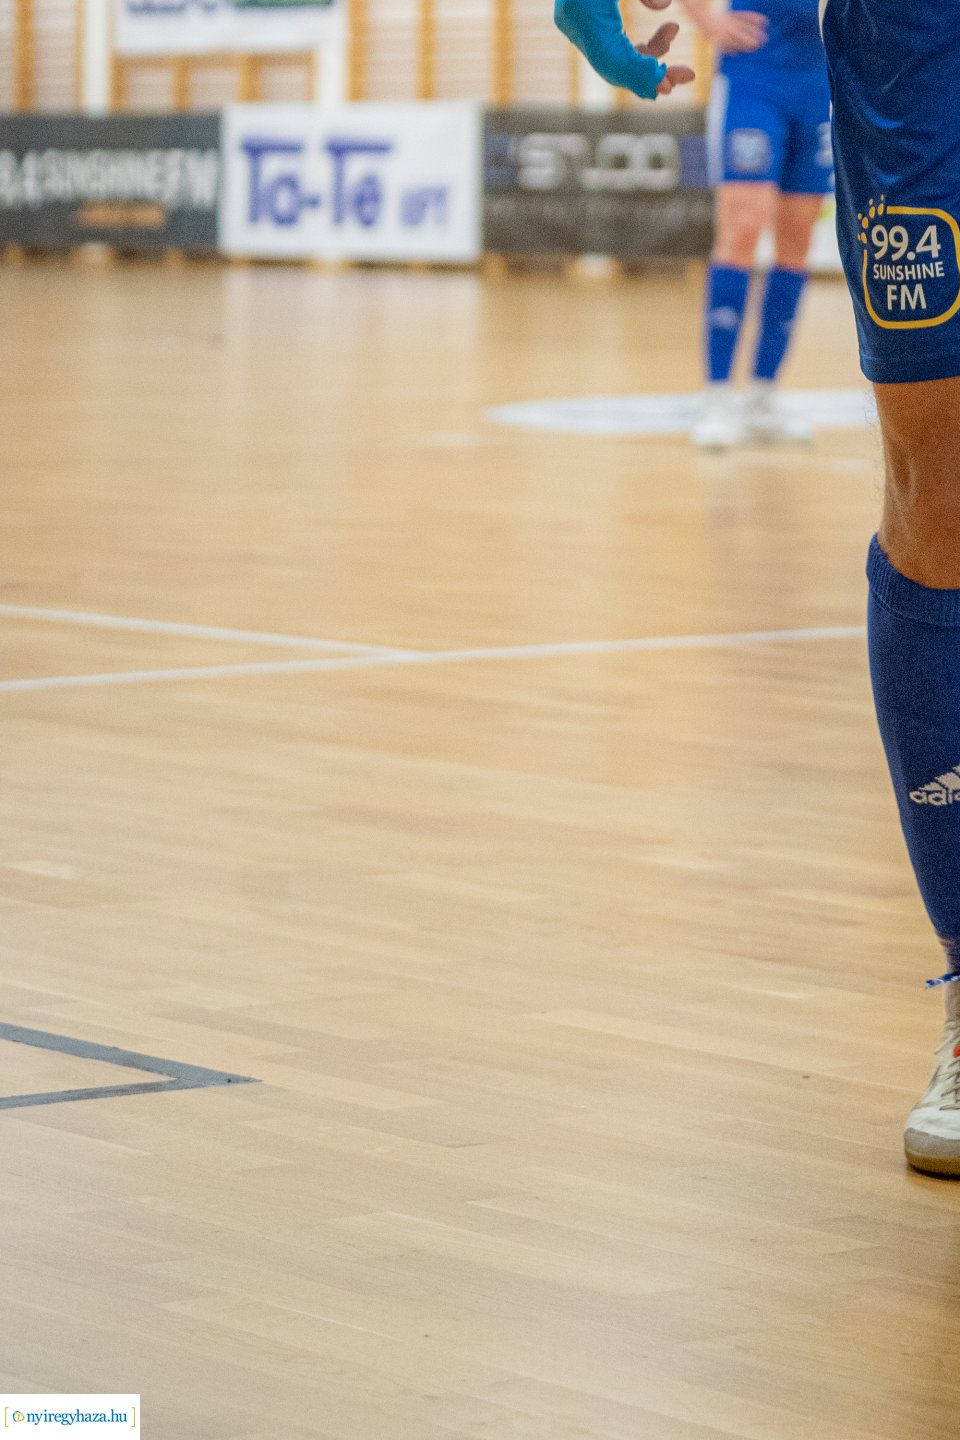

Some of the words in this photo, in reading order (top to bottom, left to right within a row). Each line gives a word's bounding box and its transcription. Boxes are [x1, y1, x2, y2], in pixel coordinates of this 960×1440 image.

[871, 224, 942, 261] 99.4
[873, 261, 945, 281] SUNSHINE
[886, 283, 927, 311] FM
